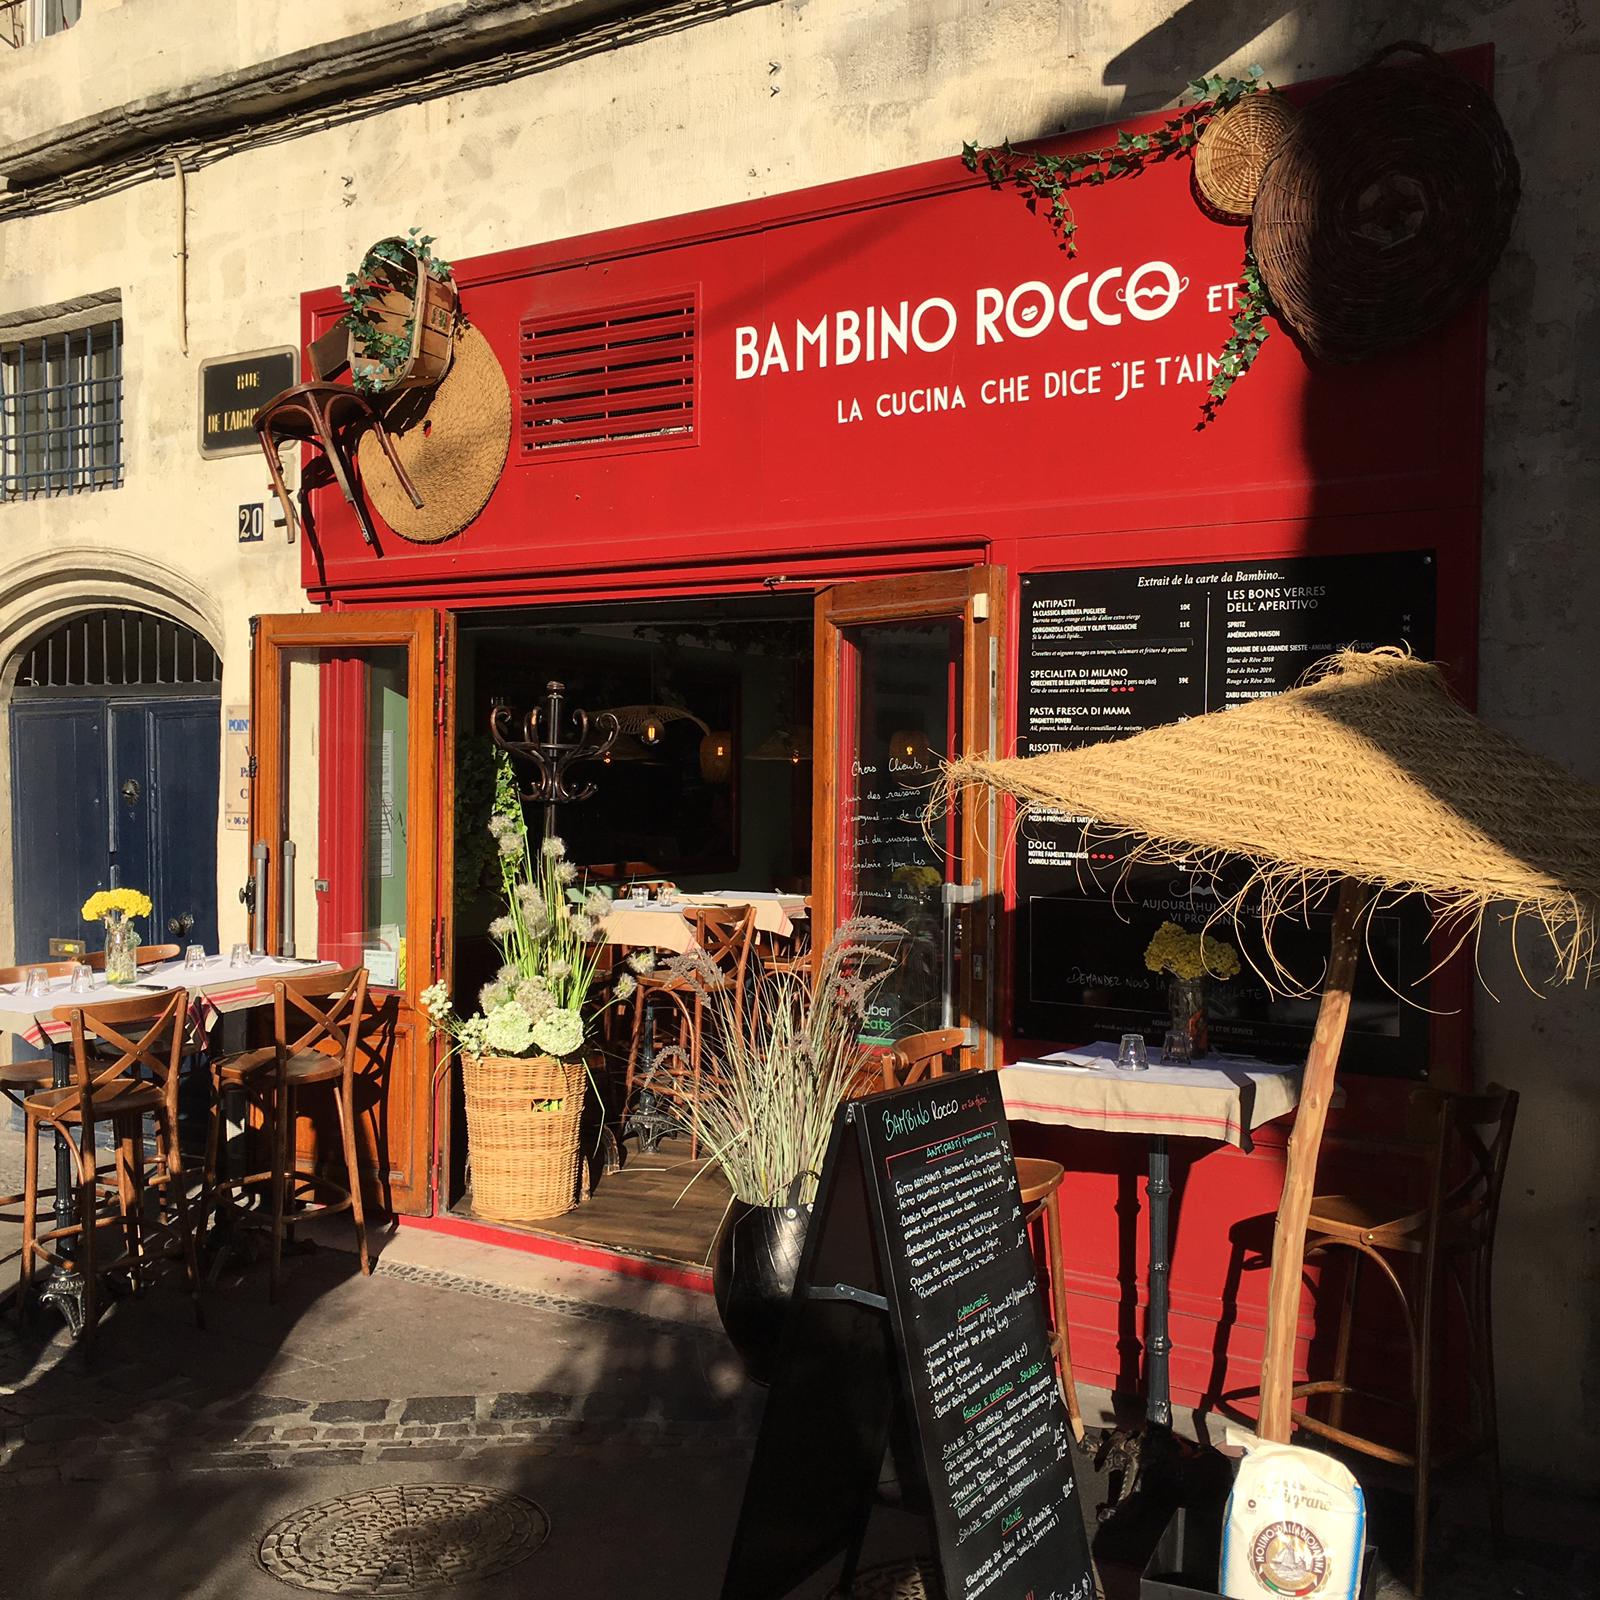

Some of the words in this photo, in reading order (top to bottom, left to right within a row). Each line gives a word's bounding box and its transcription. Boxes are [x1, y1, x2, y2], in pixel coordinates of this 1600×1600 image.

[735, 297, 957, 381] BAMBINO
[976, 261, 1188, 346] ROCCO
[1206, 282, 1239, 313] ET
[236, 371, 260, 391] RUE
[837, 397, 864, 424] LA
[876, 385, 967, 418] CUCINA
[980, 377, 1031, 406] CHE
[1044, 367, 1102, 399] DICE
[207, 412, 221, 433] DE
[240, 507, 263, 538] 20
[1137, 575, 1170, 588] Extrait
[1172, 574, 1182, 585] de
[1185, 573, 1194, 585] la
[1196, 574, 1219, 584] carte
[1221, 573, 1233, 583] da
[1235, 571, 1286, 583] Bambino...
[1227, 590, 1245, 599] LES
[1248, 588, 1281, 599] BONS
[1283, 586, 1326, 598] VERRES
[1032, 599, 1076, 609] ANTIPASTI
[1227, 602, 1256, 612] DELL'
[1258, 600, 1318, 611] APERITIVO
[1061, 608, 1082, 616] BURRATA
[1032, 626, 1063, 634] GORGONZOLA
[1107, 623, 1138, 631] TAGGIASCHE
[1227, 630, 1258, 638] AMÉRICANO
[1227, 645, 1251, 653] DOMAINE
[1252, 645, 1259, 653] DE
[1030, 669, 1077, 678] SPECIALITA
[1079, 669, 1089, 678] DI
[1091, 668, 1128, 677] MILANO
[1029, 707, 1054, 716] PASTA
[1056, 707, 1089, 716] FRESCA
[1090, 706, 1100, 715] DI
[1102, 706, 1131, 715] MAMA
[1029, 743, 1062, 752] RISOTTI
[1028, 841, 1056, 850] DOLCI
[1065, 851, 1088, 859] TIRAMISU
[1170, 913, 1182, 922] VI
[882, 1101, 930, 1141] BAMBINO
